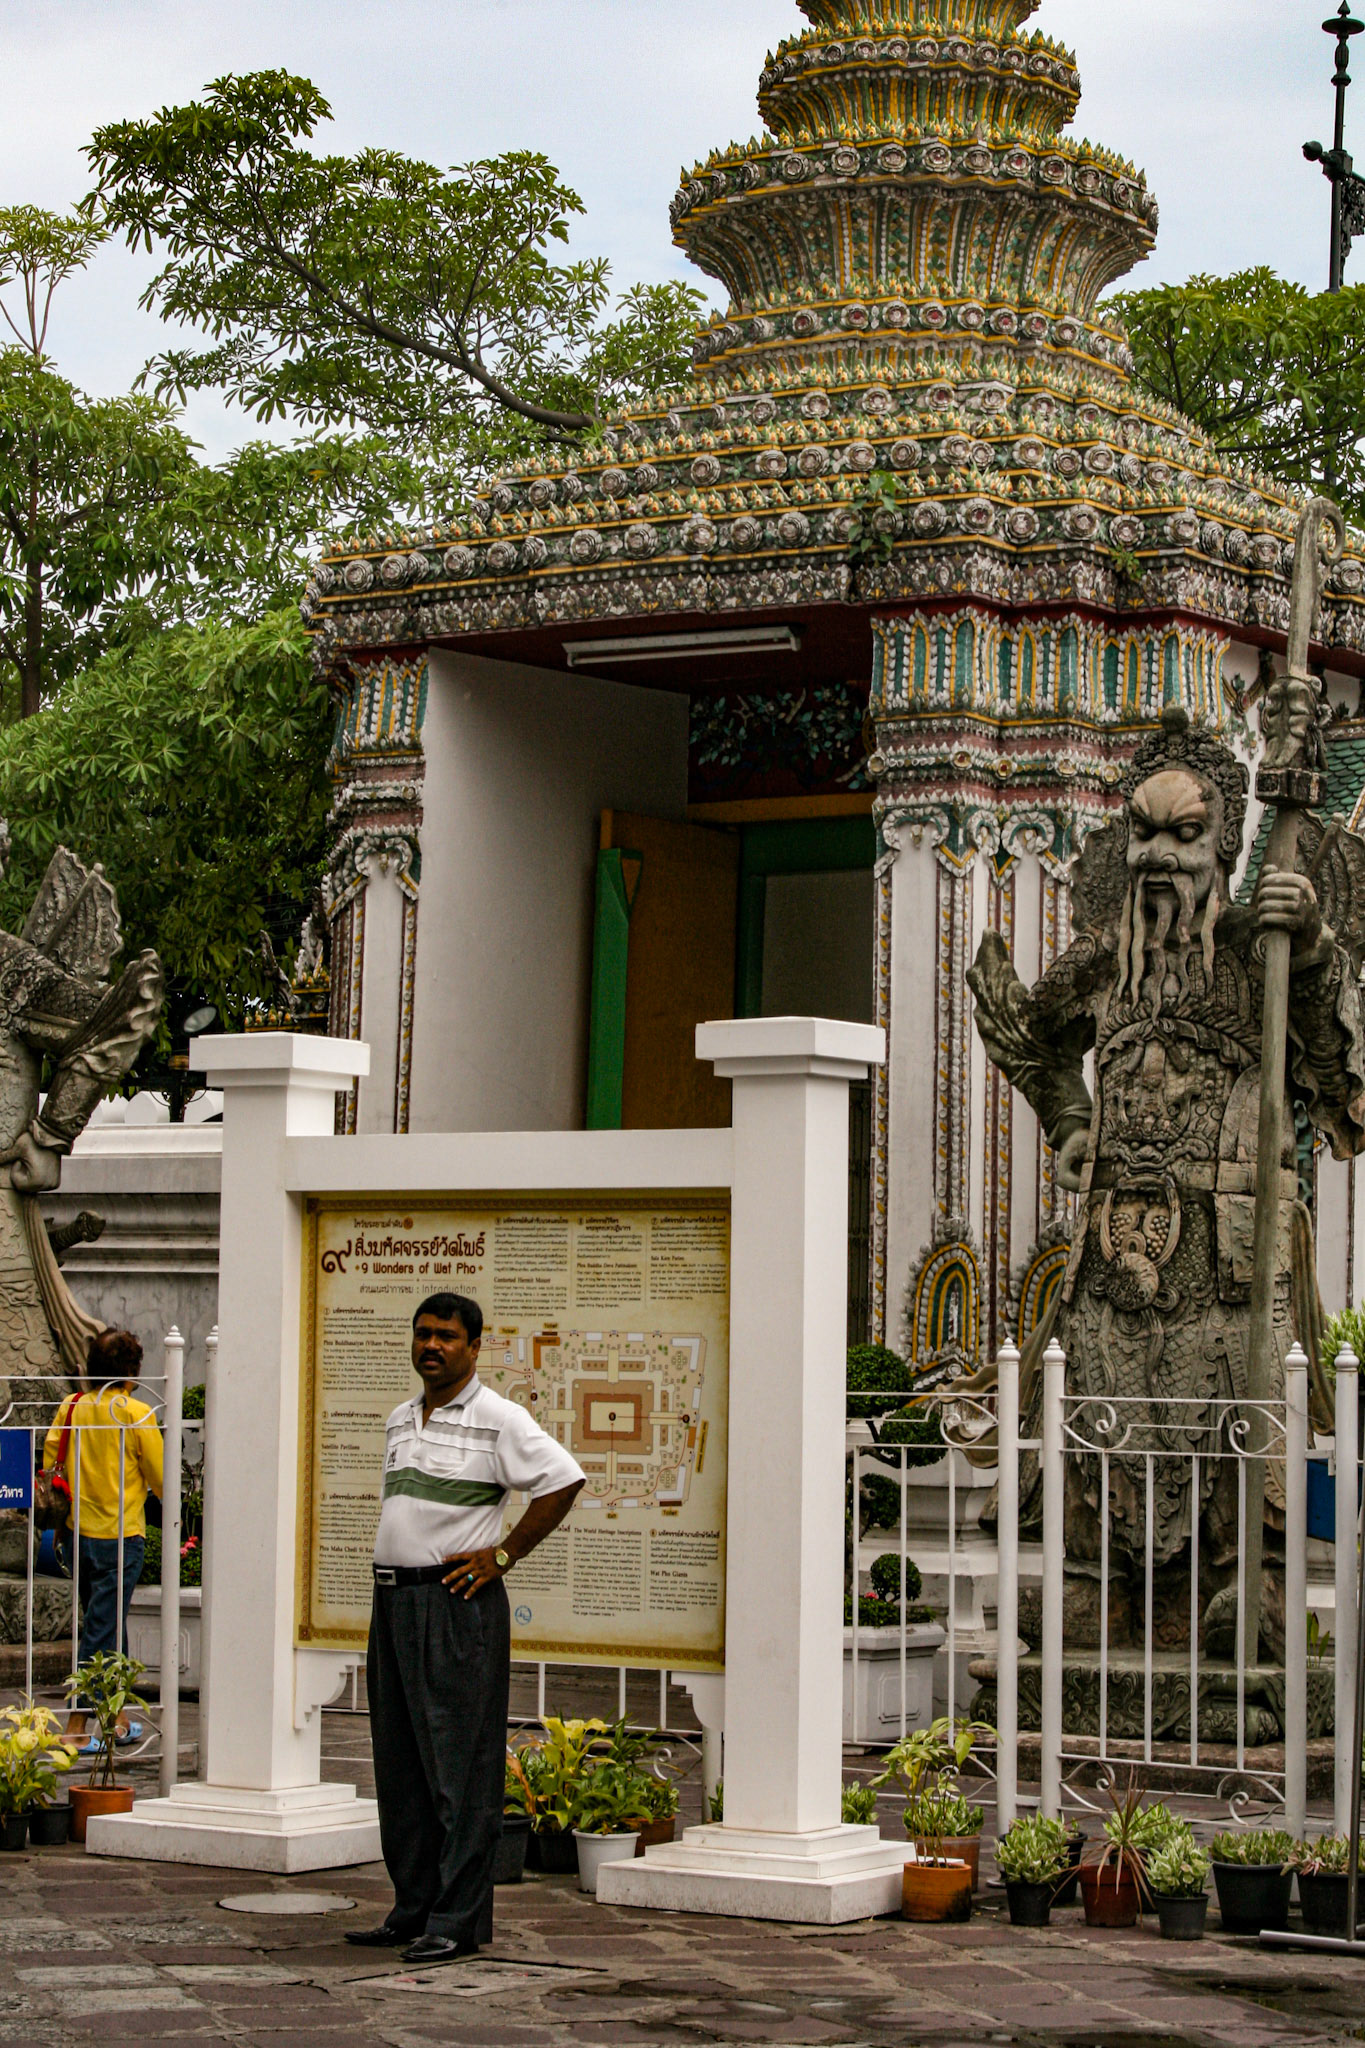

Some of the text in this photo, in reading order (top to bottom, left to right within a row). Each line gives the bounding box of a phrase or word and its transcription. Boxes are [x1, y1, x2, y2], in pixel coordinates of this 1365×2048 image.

[355, 1232, 486, 1256] สิ่งมหัศจรรย์วัดโพธิ์
[362, 1262, 475, 1274] 9 Wonders of Wat Pho
[422, 1285, 477, 1294] Introduction
